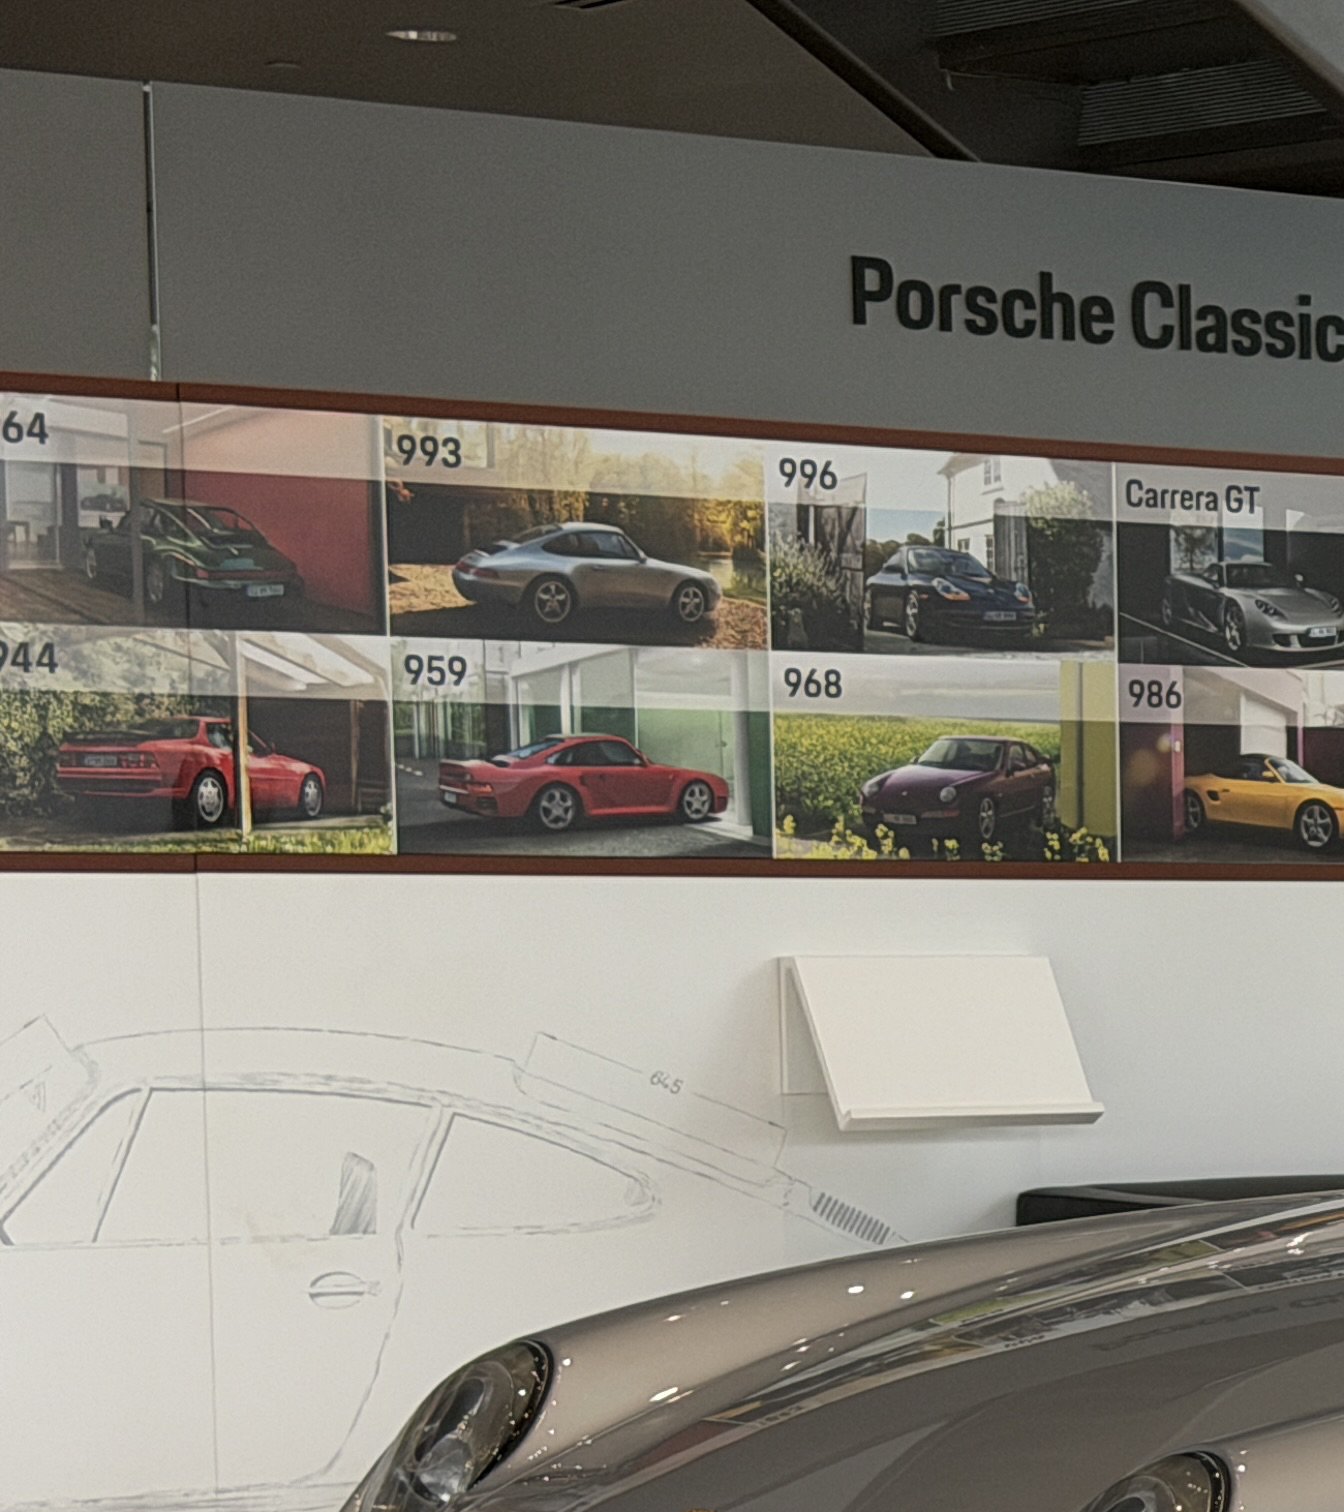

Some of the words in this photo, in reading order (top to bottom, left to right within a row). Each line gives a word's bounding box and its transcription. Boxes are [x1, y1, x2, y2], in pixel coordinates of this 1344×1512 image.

[851, 256, 1114, 345] Porsche
[397, 434, 462, 469] 993
[779, 457, 838, 490] 996
[1125, 478, 1218, 513] Carrera
[1224, 484, 1261, 515] GT
[403, 654, 467, 686] 959
[784, 667, 842, 699] 968
[1128, 679, 1182, 709] 986
